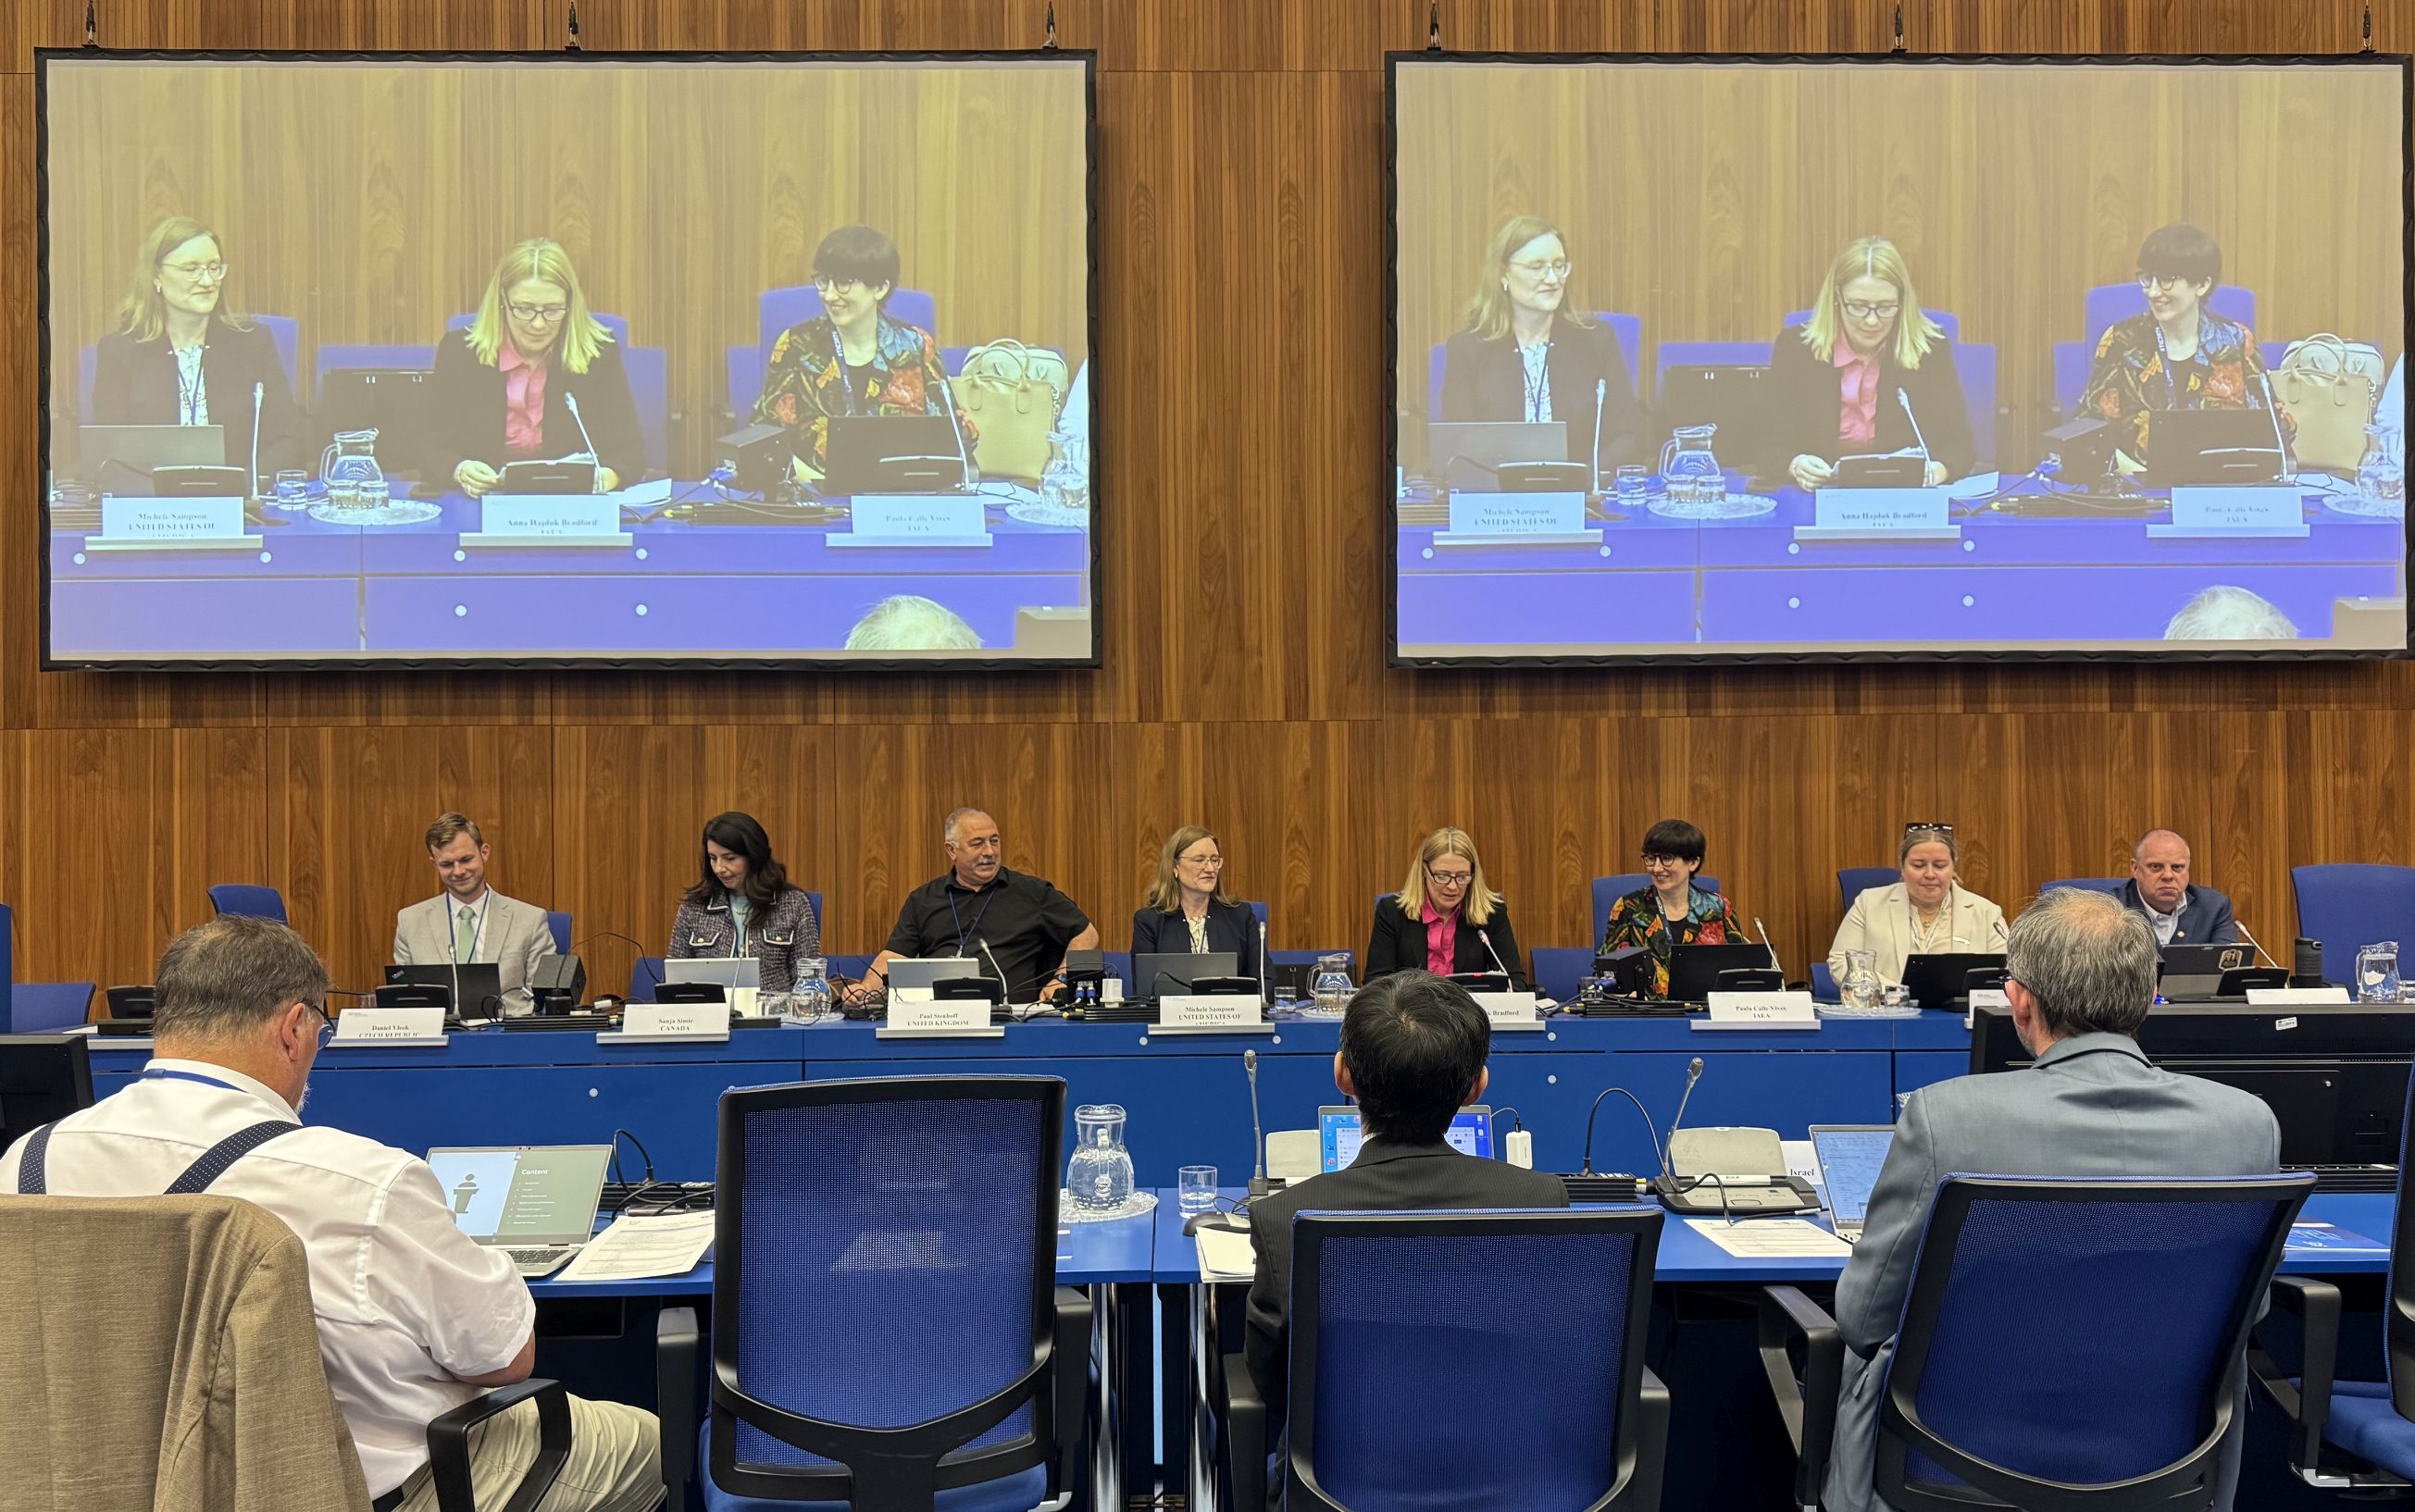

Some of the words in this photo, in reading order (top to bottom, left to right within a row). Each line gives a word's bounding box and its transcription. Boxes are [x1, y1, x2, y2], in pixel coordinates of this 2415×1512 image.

[1511, 517, 1544, 526] STATES
[129, 523, 165, 531] UNITED
[167, 522, 202, 530] STATES
[1790, 1168, 1815, 1176] Israel
